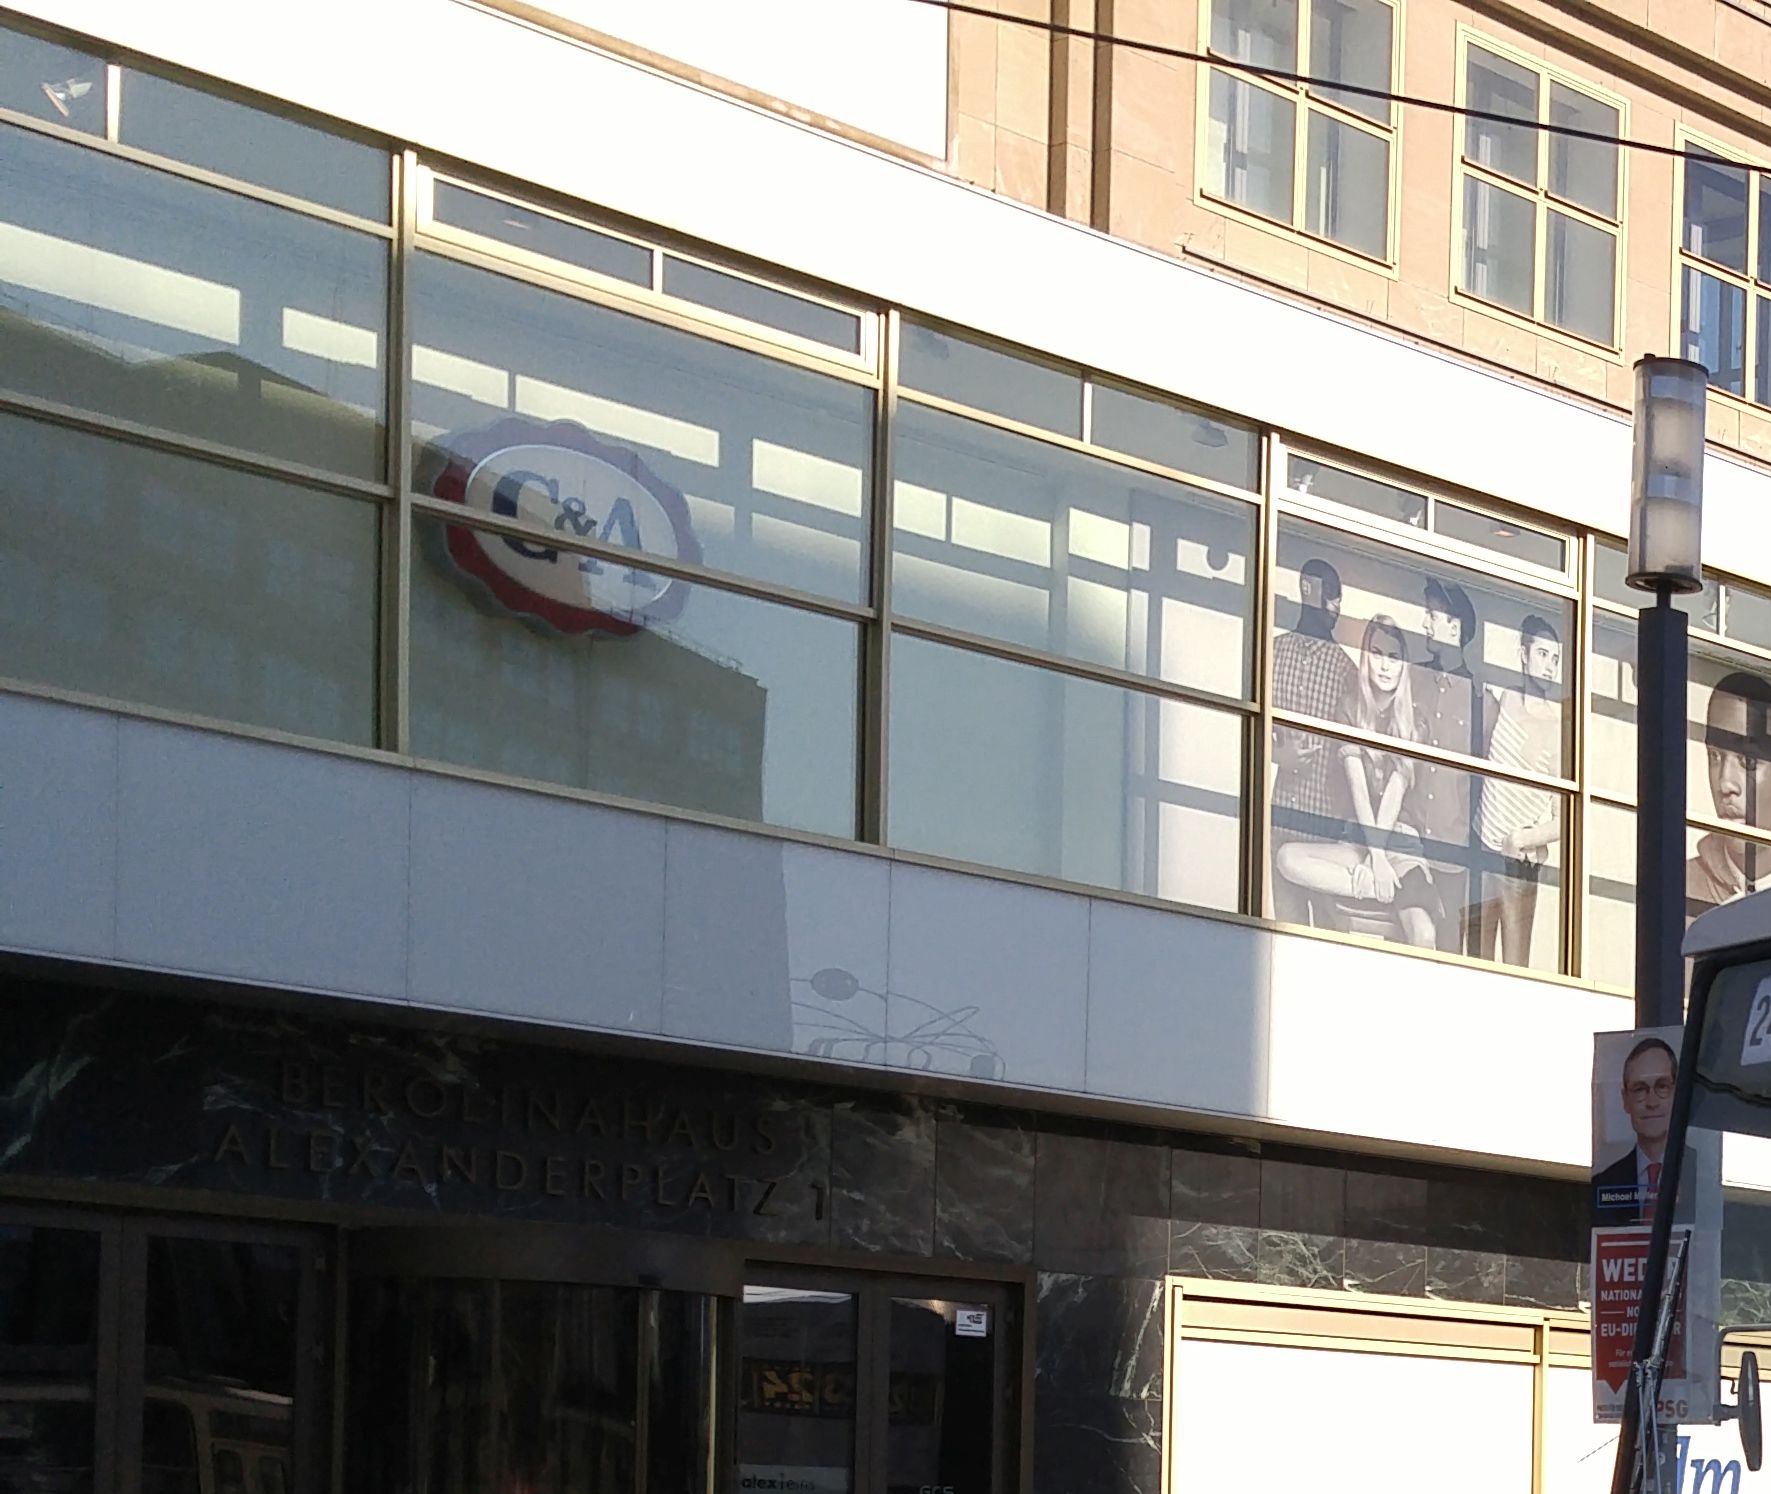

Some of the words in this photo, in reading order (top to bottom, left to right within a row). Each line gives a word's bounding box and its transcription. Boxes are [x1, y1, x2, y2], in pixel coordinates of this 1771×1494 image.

[493, 470, 657, 592] C&A
[281, 1061, 777, 1156] BEROLINAHAUS
[213, 1122, 780, 1218] ALEXANDERPLATZ
[806, 1181, 827, 1222] 1
[1601, 1191, 1632, 1202] Michael
